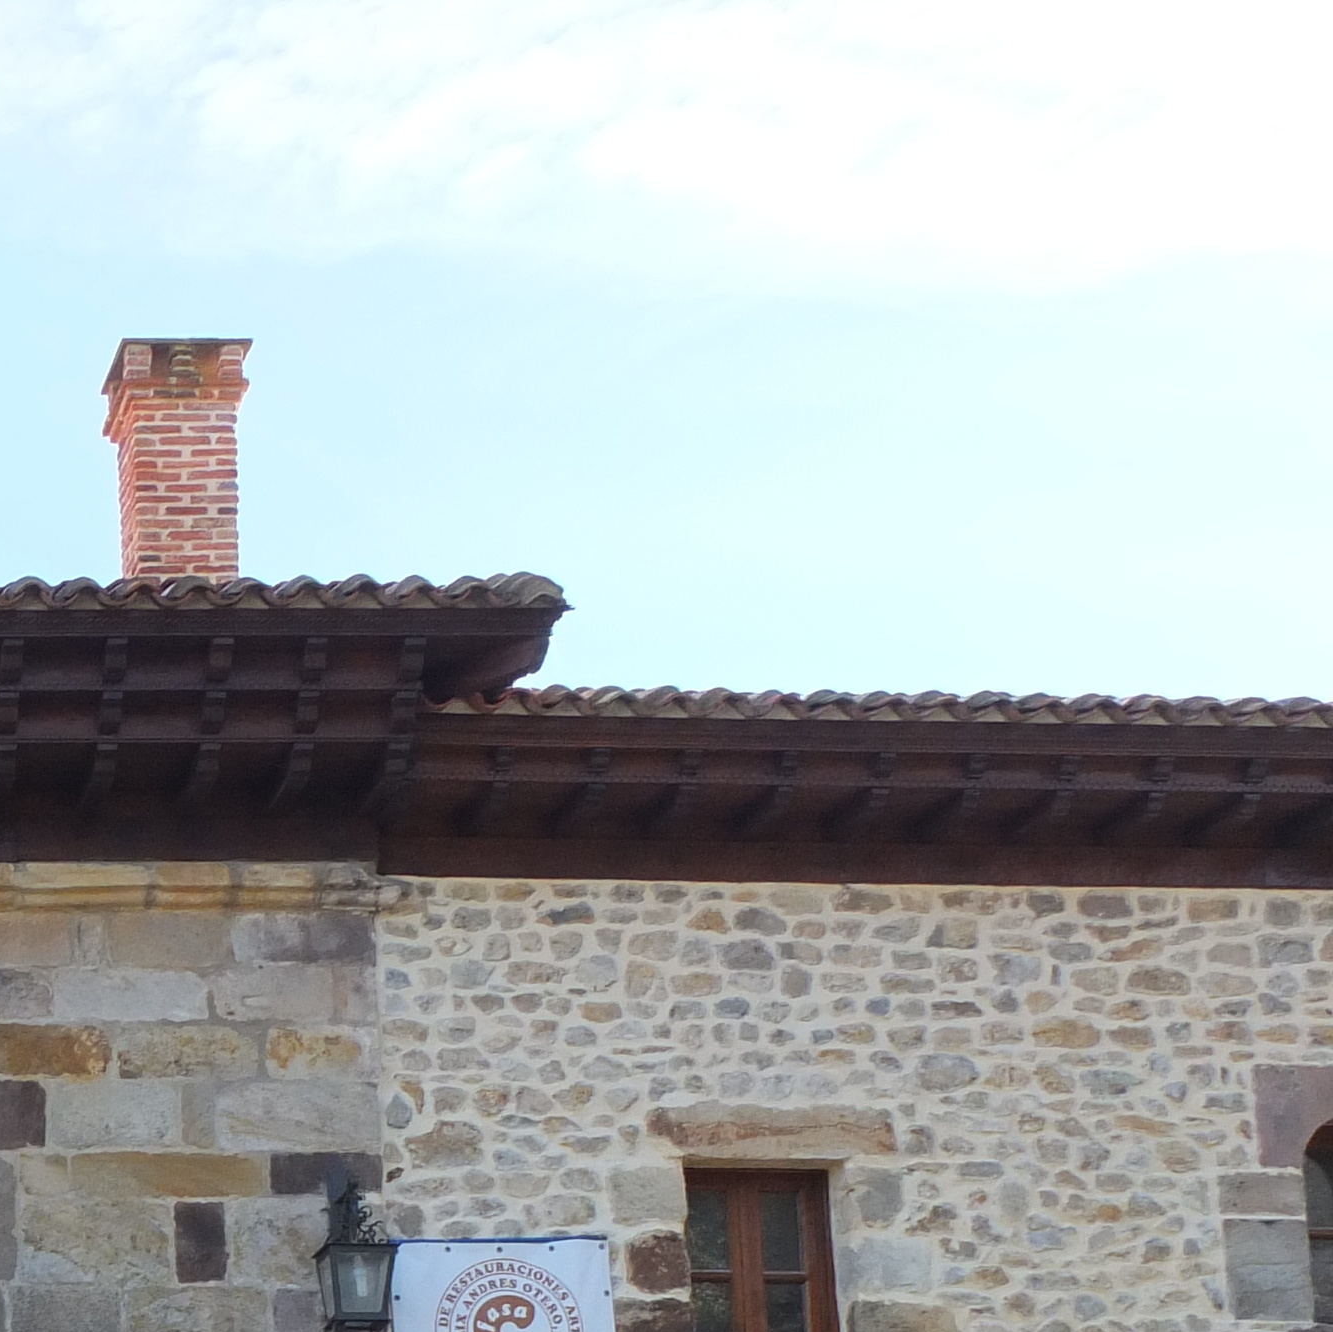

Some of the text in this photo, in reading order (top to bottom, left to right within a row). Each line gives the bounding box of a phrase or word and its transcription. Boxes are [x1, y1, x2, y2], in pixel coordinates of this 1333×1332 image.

[444, 1262, 570, 1304] RESTAURACIONES
[462, 1278, 518, 1310] ANDRES
[438, 1306, 452, 1327] DE
